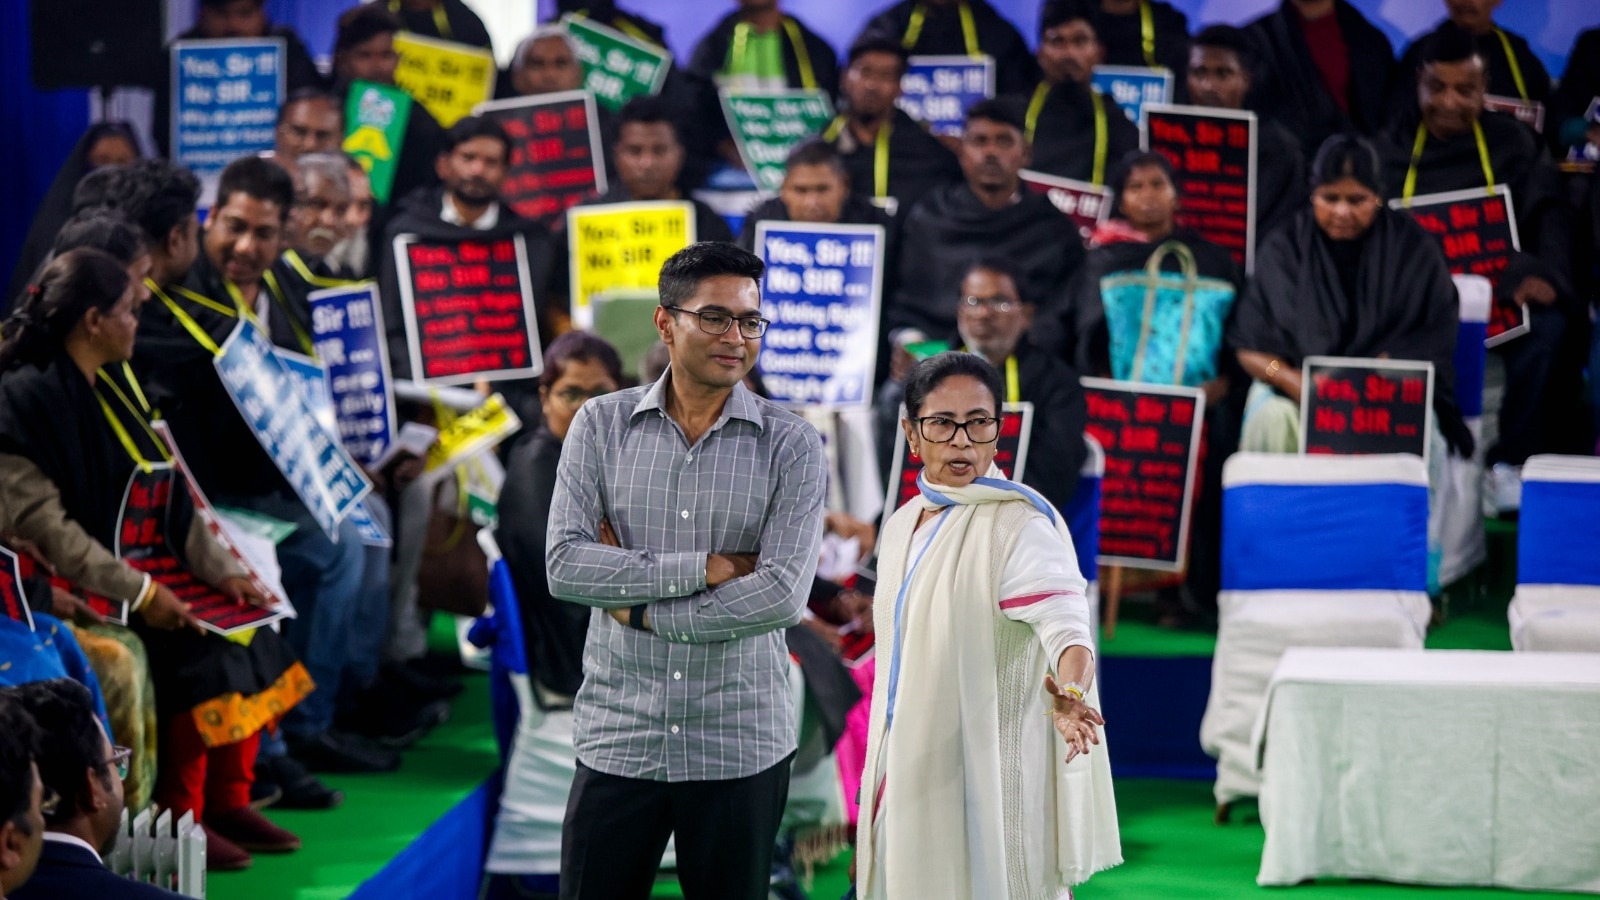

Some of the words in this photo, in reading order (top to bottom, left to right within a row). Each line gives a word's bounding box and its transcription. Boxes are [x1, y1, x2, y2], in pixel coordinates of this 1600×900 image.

[184, 55, 221, 77] Yes,
[226, 53, 253, 76] Sir
[605, 49, 633, 75] Sir
[185, 83, 212, 104] No
[217, 79, 251, 104] SIR
[900, 73, 931, 95] es,
[933, 68, 962, 94] Sir
[1111, 80, 1140, 104] Sir
[923, 95, 962, 121] SIR
[533, 110, 563, 134] Sir
[1151, 117, 1191, 144] Yes,
[1195, 121, 1224, 146] Sir
[511, 147, 525, 167] o
[527, 138, 564, 164] SIR
[1185, 149, 1221, 173] SIR
[582, 224, 621, 242] Yes,
[631, 218, 658, 236] Sir
[1450, 204, 1479, 229] Sir
[409, 245, 457, 267] Yes,
[458, 241, 489, 263] Sir
[585, 252, 613, 270] No
[622, 246, 654, 265] SIR
[766, 236, 814, 267] Yes,
[815, 239, 849, 267] Sir
[1443, 231, 1481, 259] SIR
[415, 270, 449, 292] No
[451, 264, 491, 288] SIR
[767, 266, 801, 294] No
[803, 268, 844, 296] SIR
[313, 304, 345, 335] Sir
[779, 301, 828, 329] Voting
[765, 327, 813, 351] not
[1313, 373, 1359, 403] Yes,
[1365, 374, 1396, 403] Sir
[1085, 391, 1131, 422] Yes,
[1135, 395, 1167, 423] Sir
[1315, 405, 1347, 433] No
[1352, 406, 1391, 434] SIR
[1119, 425, 1160, 452] SIR
